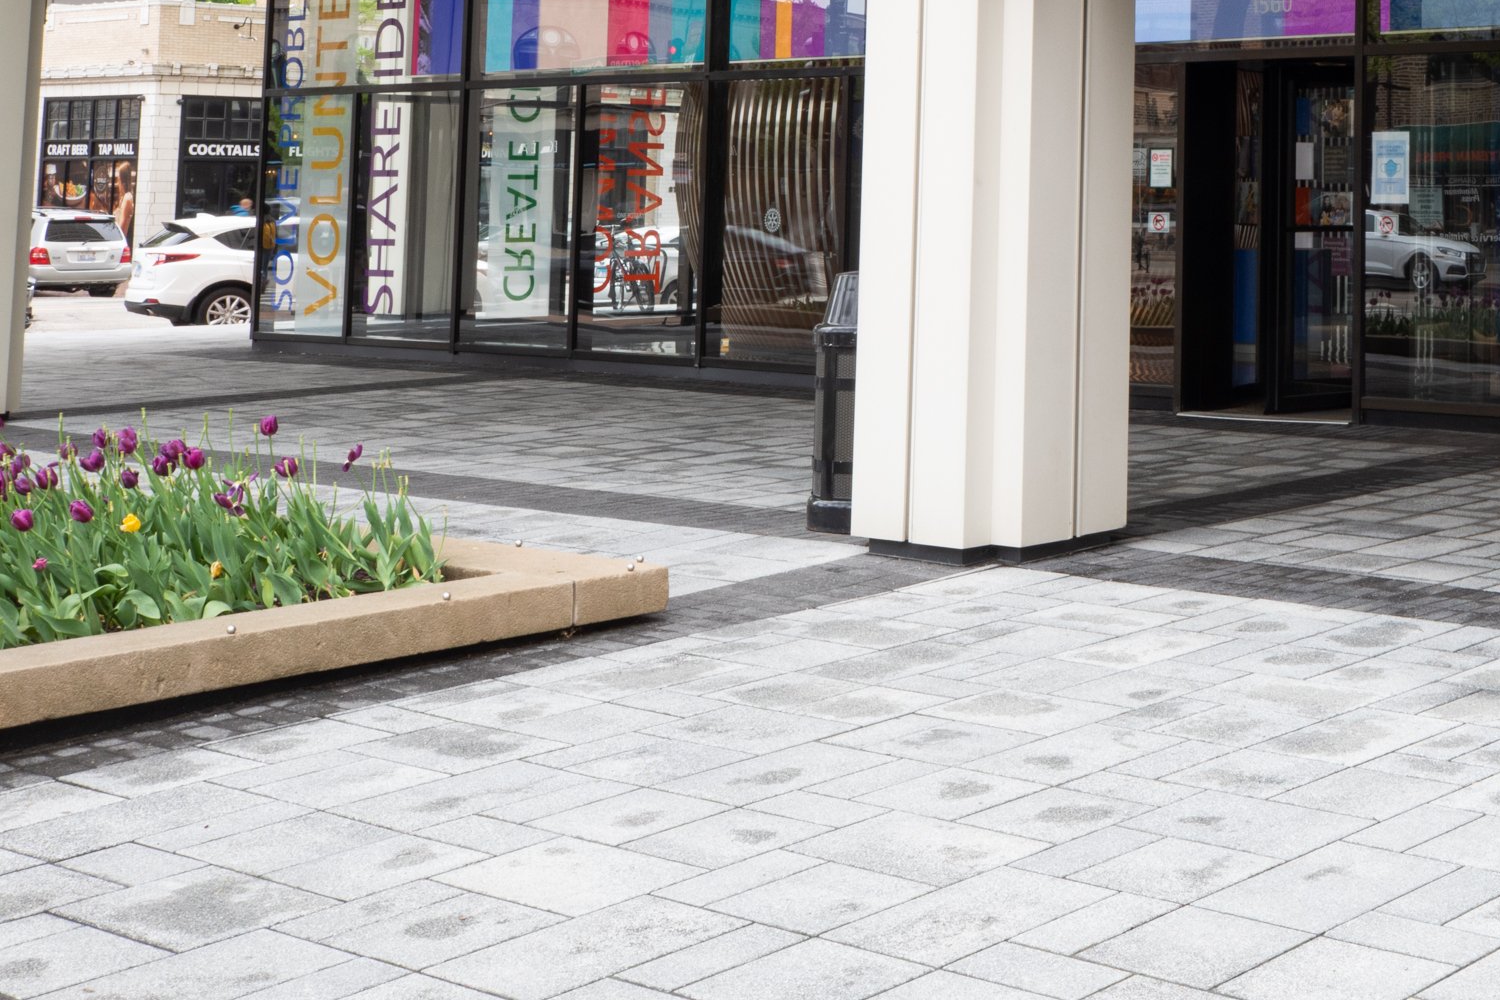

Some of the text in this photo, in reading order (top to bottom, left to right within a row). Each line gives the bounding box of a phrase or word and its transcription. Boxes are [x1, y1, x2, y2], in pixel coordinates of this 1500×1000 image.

[47, 143, 88, 156] CRAFT BEER
[98, 143, 134, 155] TAP WALL
[188, 143, 260, 157] COCKTAILS
[364, 106, 402, 314] SHARE
[272, 168, 299, 312] SOLVE
